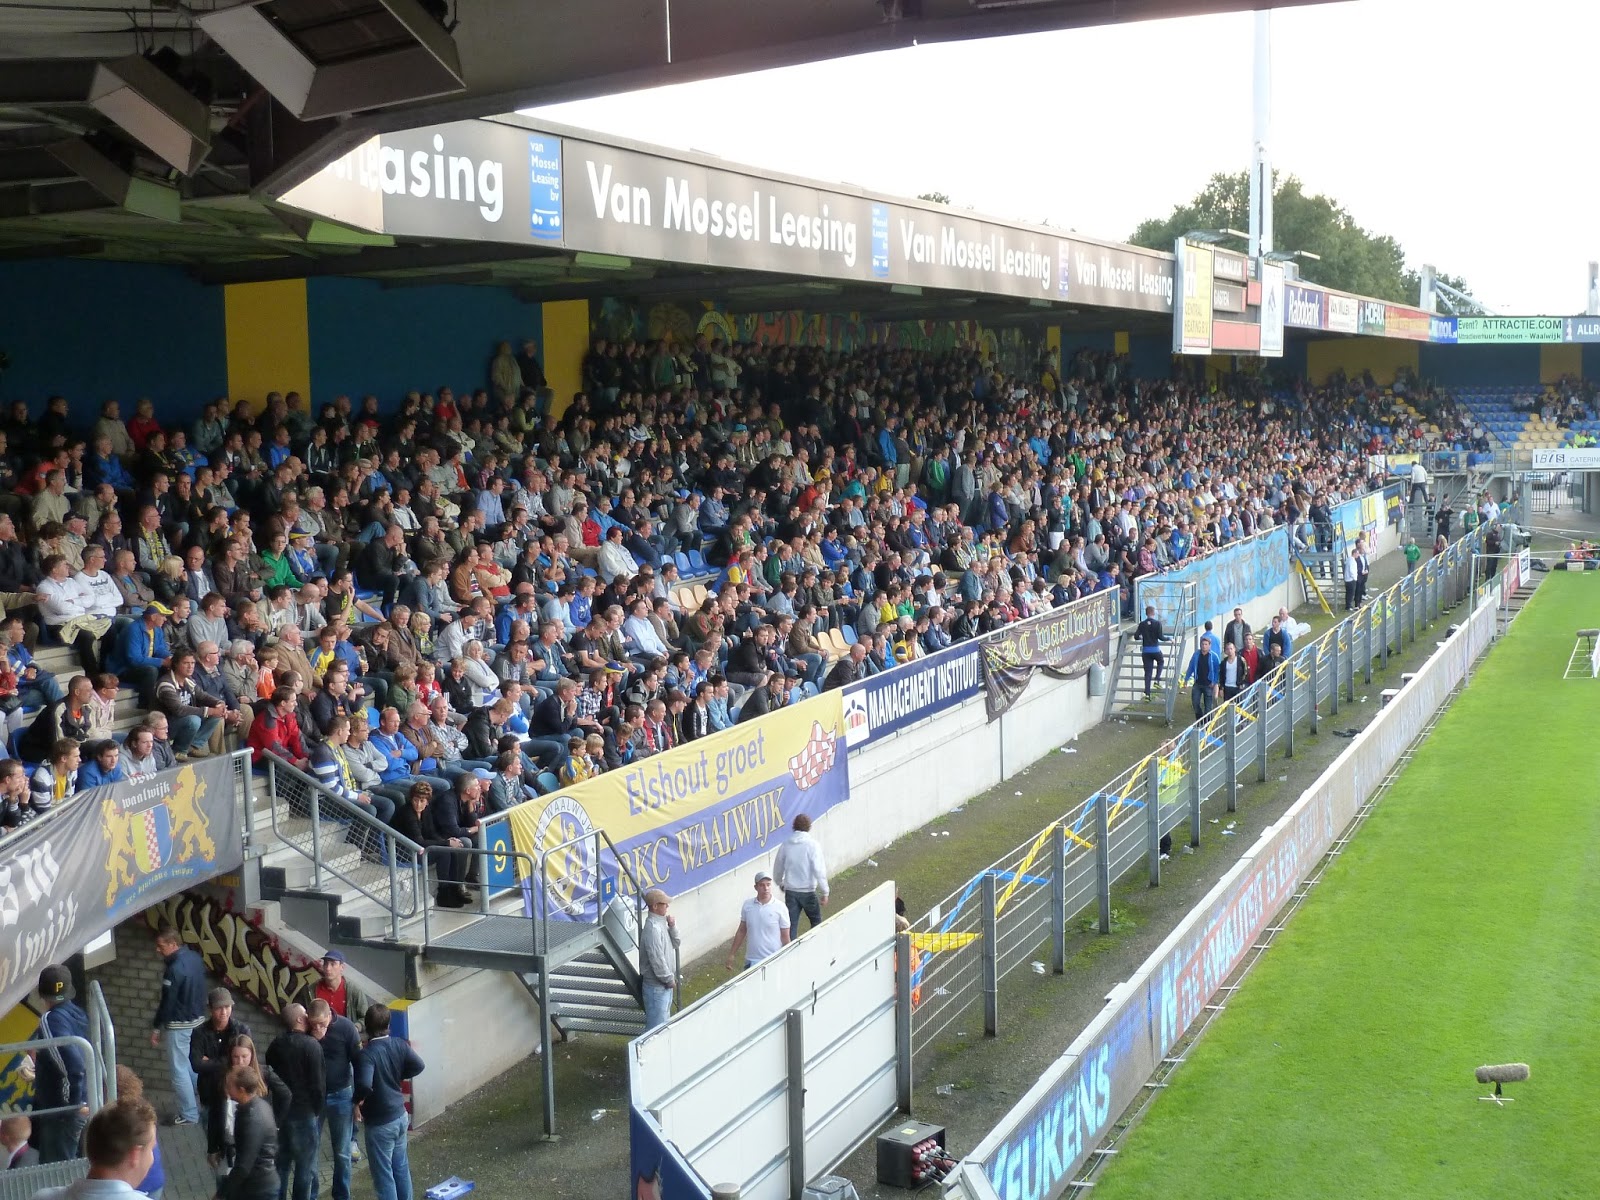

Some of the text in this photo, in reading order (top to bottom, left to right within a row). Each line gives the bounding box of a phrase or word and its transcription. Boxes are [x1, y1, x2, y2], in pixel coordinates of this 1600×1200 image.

[530, 142, 544, 152] van
[531, 155, 558, 170] Mossel
[532, 170, 559, 190] Leasing
[586, 160, 857, 267] Van Mossel Leasing
[900, 219, 935, 265] Van
[941, 226, 995, 272] Mossel
[1000, 238, 1051, 290] Leasing
[1075, 252, 1097, 287] Van
[1101, 257, 1135, 292] Mossel
[1139, 262, 1173, 304] Leasing
[1288, 288, 1320, 326] Rabobank
[1458, 320, 1562, 330] Event? ATTRACTIE.COM
[1530, 333, 1561, 341] Waalwijk
[1112, 599, 1117, 616] 8
[868, 667, 936, 731] MANAGEMENT
[937, 650, 979, 700] INSTITUUT
[625, 728, 766, 817] Elshout groet
[122, 781, 170, 809] waalwijk
[494, 839, 507, 873] 9
[614, 836, 670, 897] RKC
[675, 786, 786, 874] WAALWIJK
[56, 981, 64, 992] P
